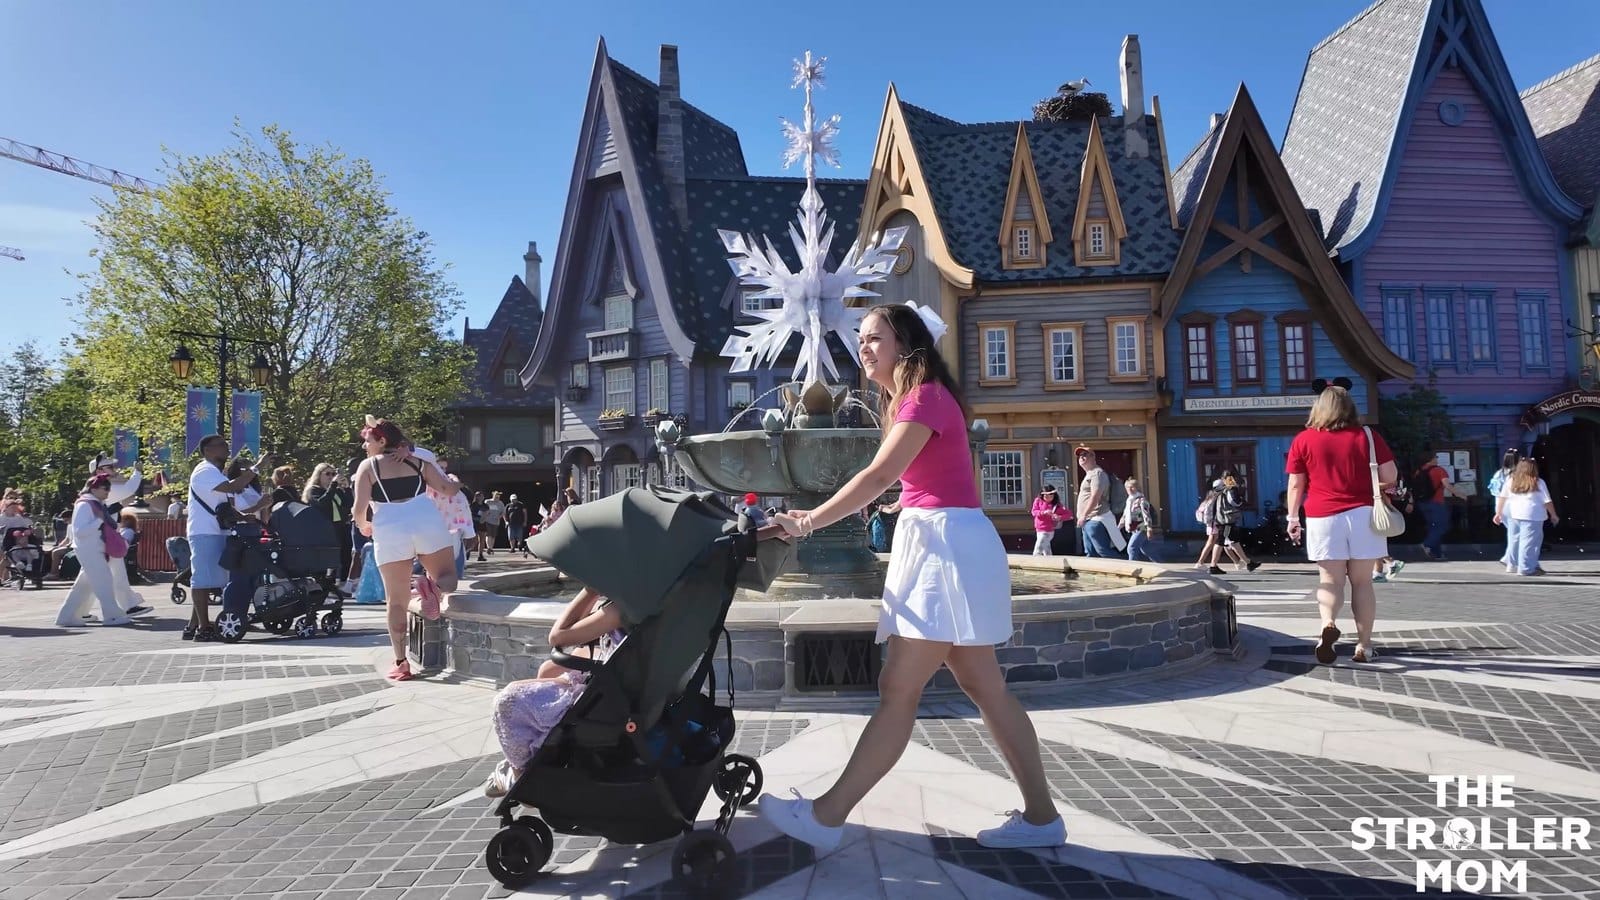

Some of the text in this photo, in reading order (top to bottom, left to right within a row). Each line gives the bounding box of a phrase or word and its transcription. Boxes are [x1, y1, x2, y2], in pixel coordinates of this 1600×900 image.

[1190, 400, 1248, 409] ARENDELLE
[1252, 398, 1281, 407] DAILY
[1540, 397, 1571, 415] Nordic
